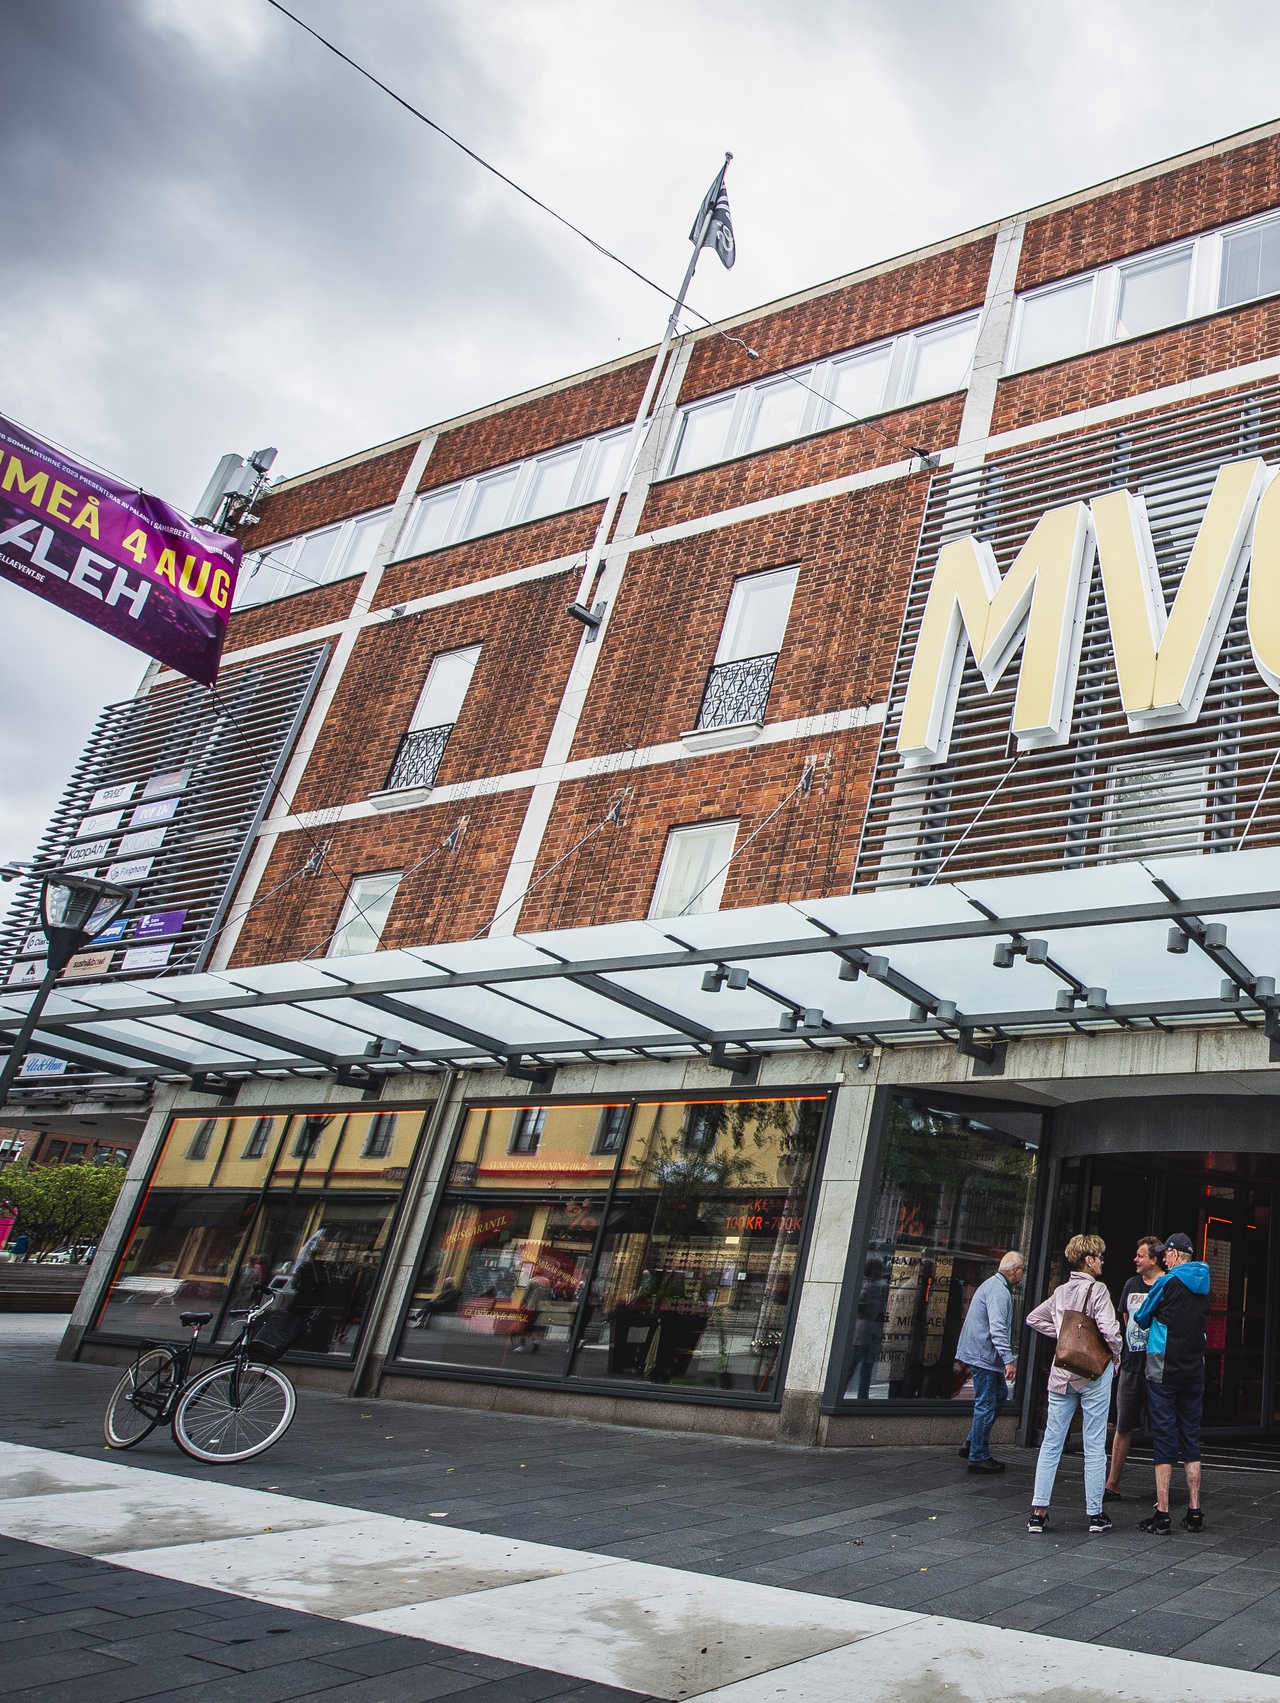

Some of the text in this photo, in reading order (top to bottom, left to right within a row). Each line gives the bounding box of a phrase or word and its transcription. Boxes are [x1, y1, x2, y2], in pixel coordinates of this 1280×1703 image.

[7, 437, 61, 469] SOMMARTURNÉ
[62, 465, 79, 478] 2023
[79, 476, 121, 504] PRESENTERAS
[121, 501, 129, 509] AV
[153, 522, 190, 540] SAMARBETE
[0, 449, 231, 609] MEÅ 4 AUG
[140, 804, 170, 821] POP IN
[122, 830, 163, 851] KICKS
[66, 842, 108, 861] KappAhl
[898, 1316, 946, 1327] MICAEL
